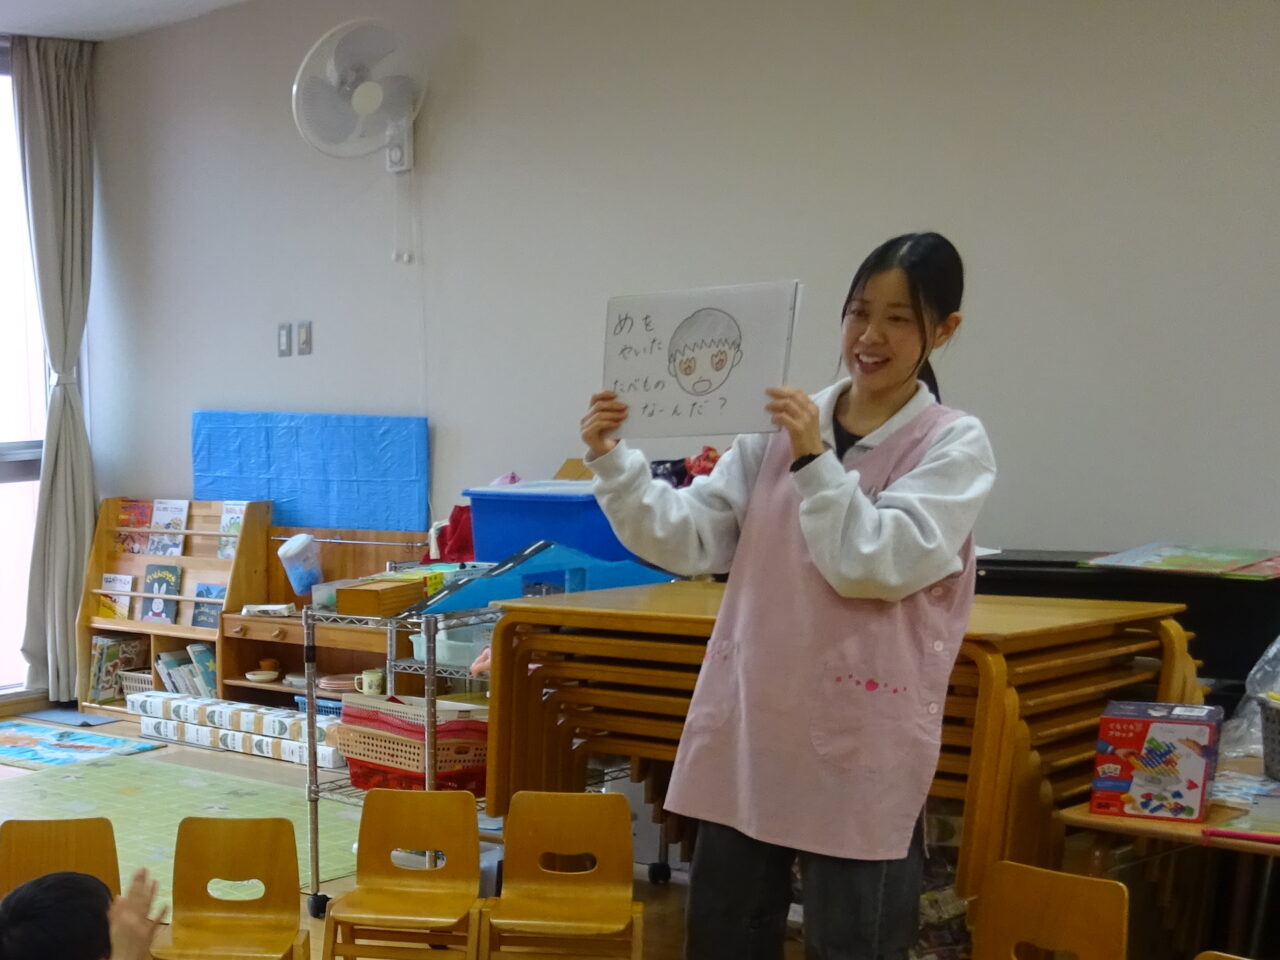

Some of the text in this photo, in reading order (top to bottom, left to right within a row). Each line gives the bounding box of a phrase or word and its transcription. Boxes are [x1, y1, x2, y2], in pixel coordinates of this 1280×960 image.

[613, 312, 655, 336] めを
[613, 376, 665, 393] たべもの
